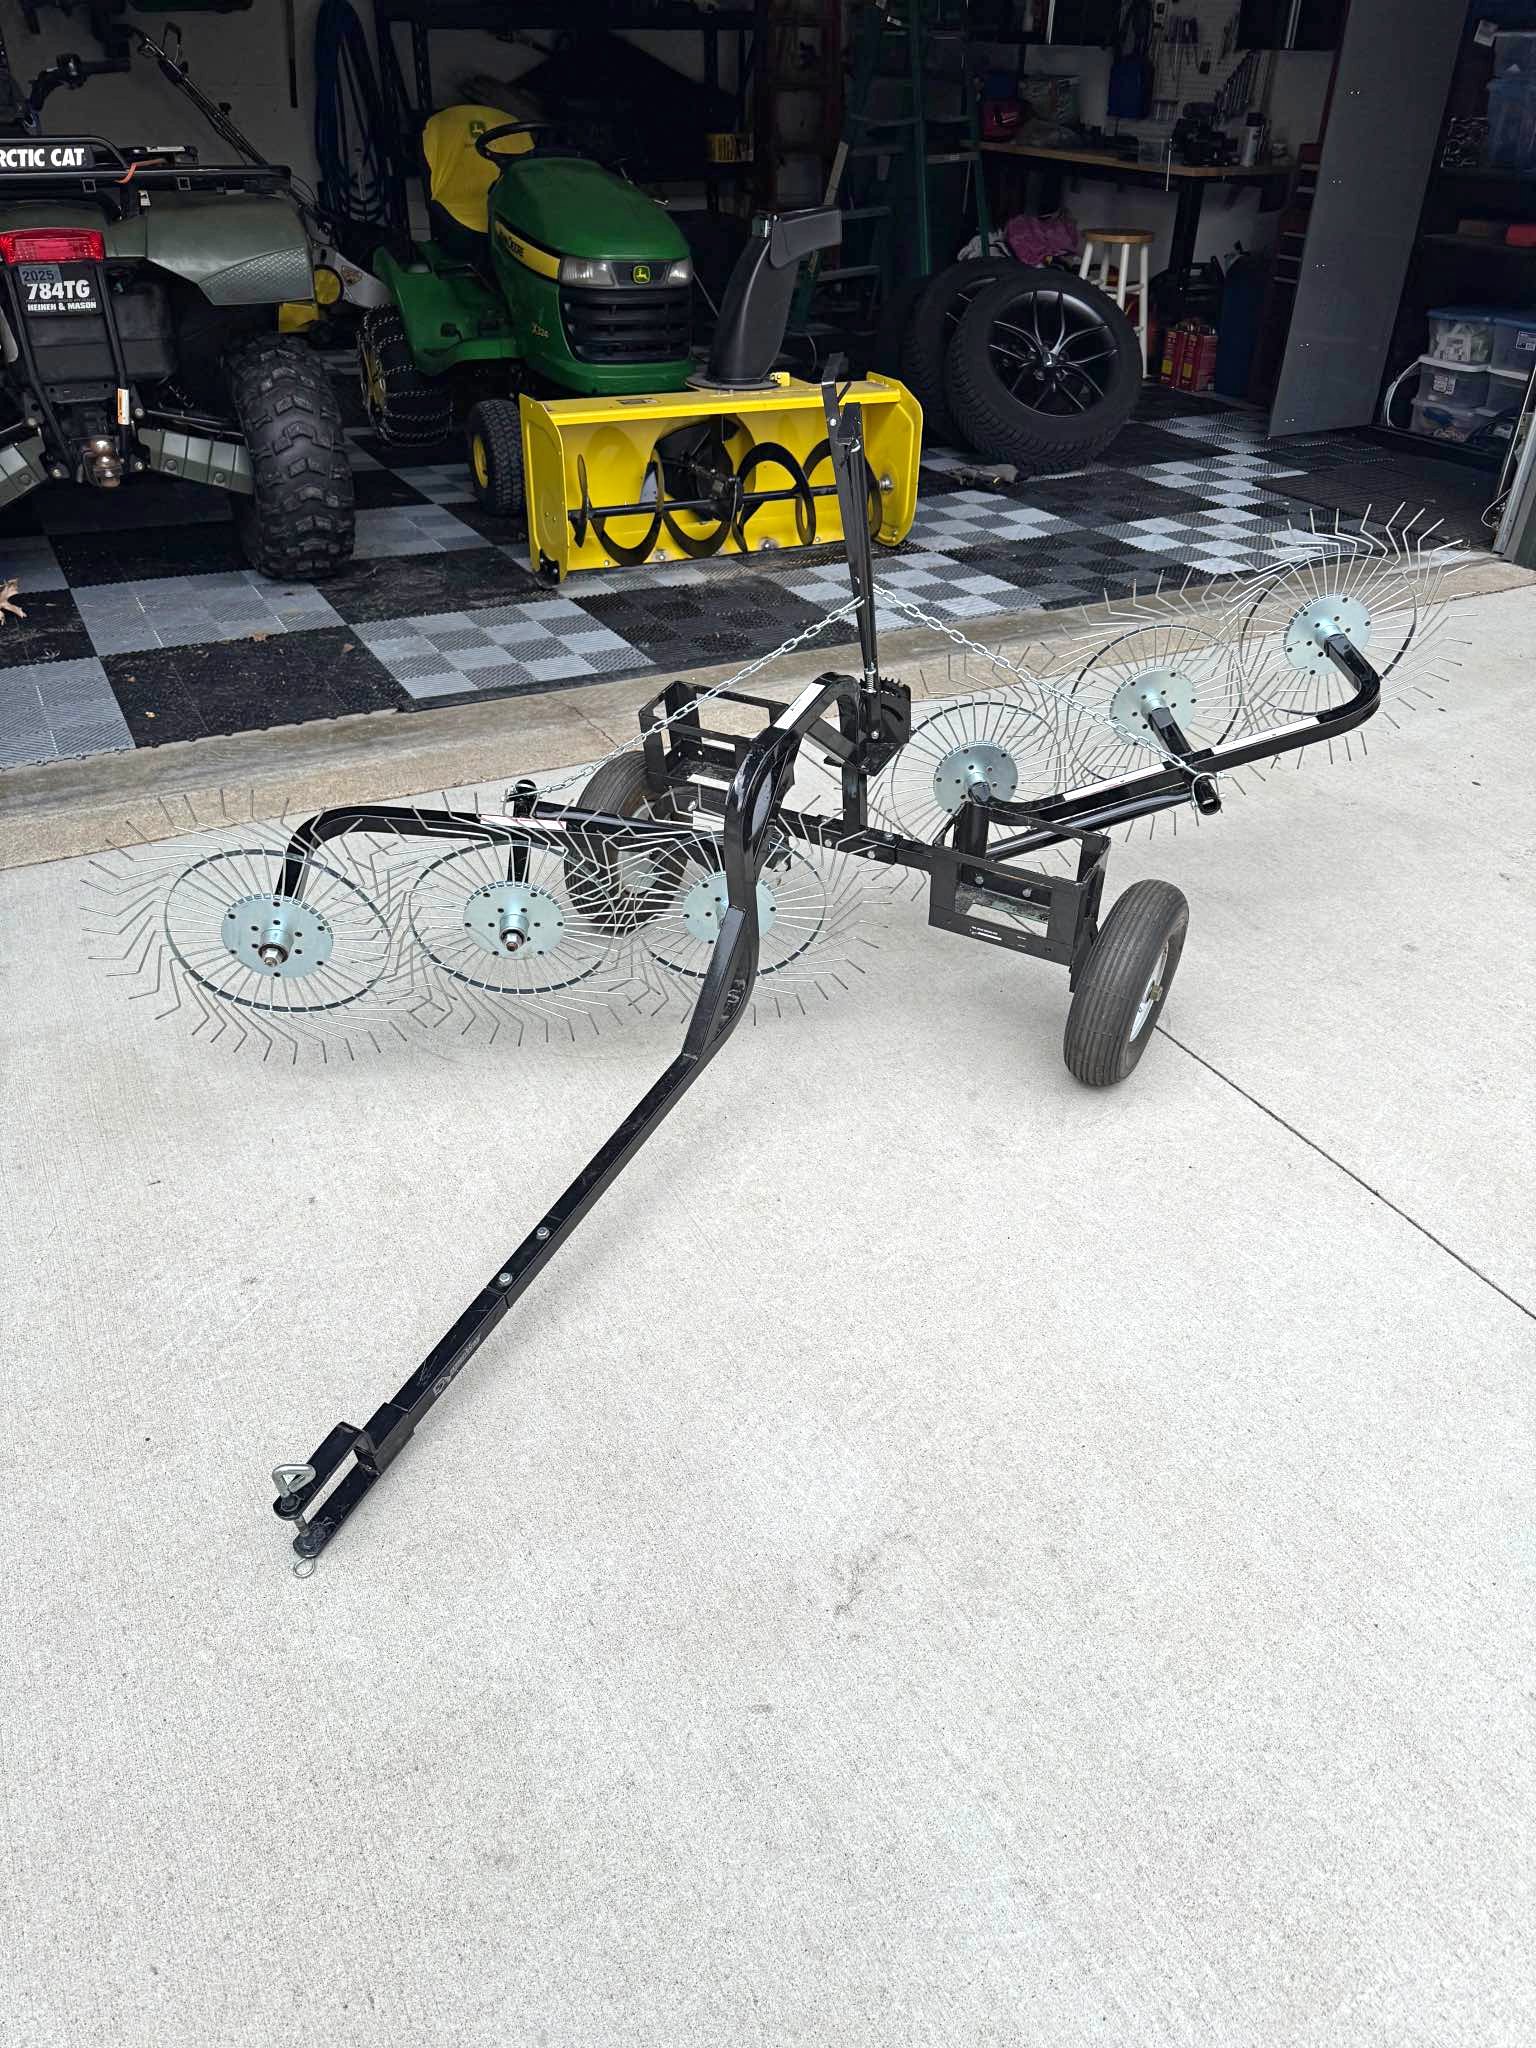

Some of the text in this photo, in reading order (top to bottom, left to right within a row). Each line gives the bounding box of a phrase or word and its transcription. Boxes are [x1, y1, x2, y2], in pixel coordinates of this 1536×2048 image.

[50, 148, 85, 167] CAT
[22, 270, 55, 281] 2025
[27, 280, 90, 300] 784TG
[58, 302, 66, 311] &
[67, 301, 97, 310] MASON
